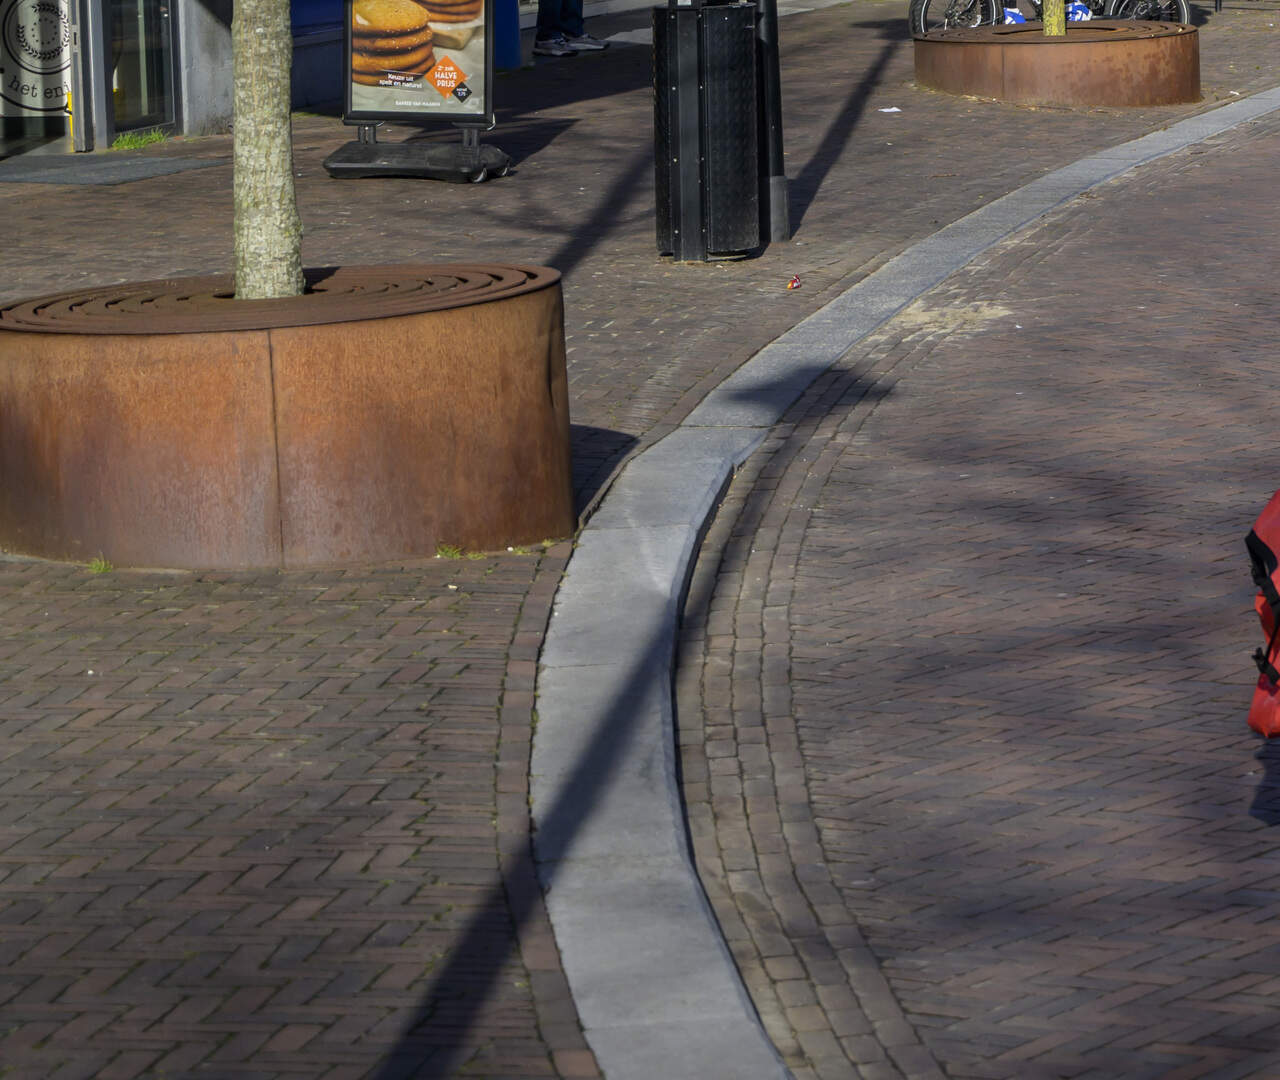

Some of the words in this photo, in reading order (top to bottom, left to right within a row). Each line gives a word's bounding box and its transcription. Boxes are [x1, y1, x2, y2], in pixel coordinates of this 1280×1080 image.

[434, 71, 458, 80] HALVE
[436, 79, 456, 88] PRIJS
[8, 76, 38, 101] het
